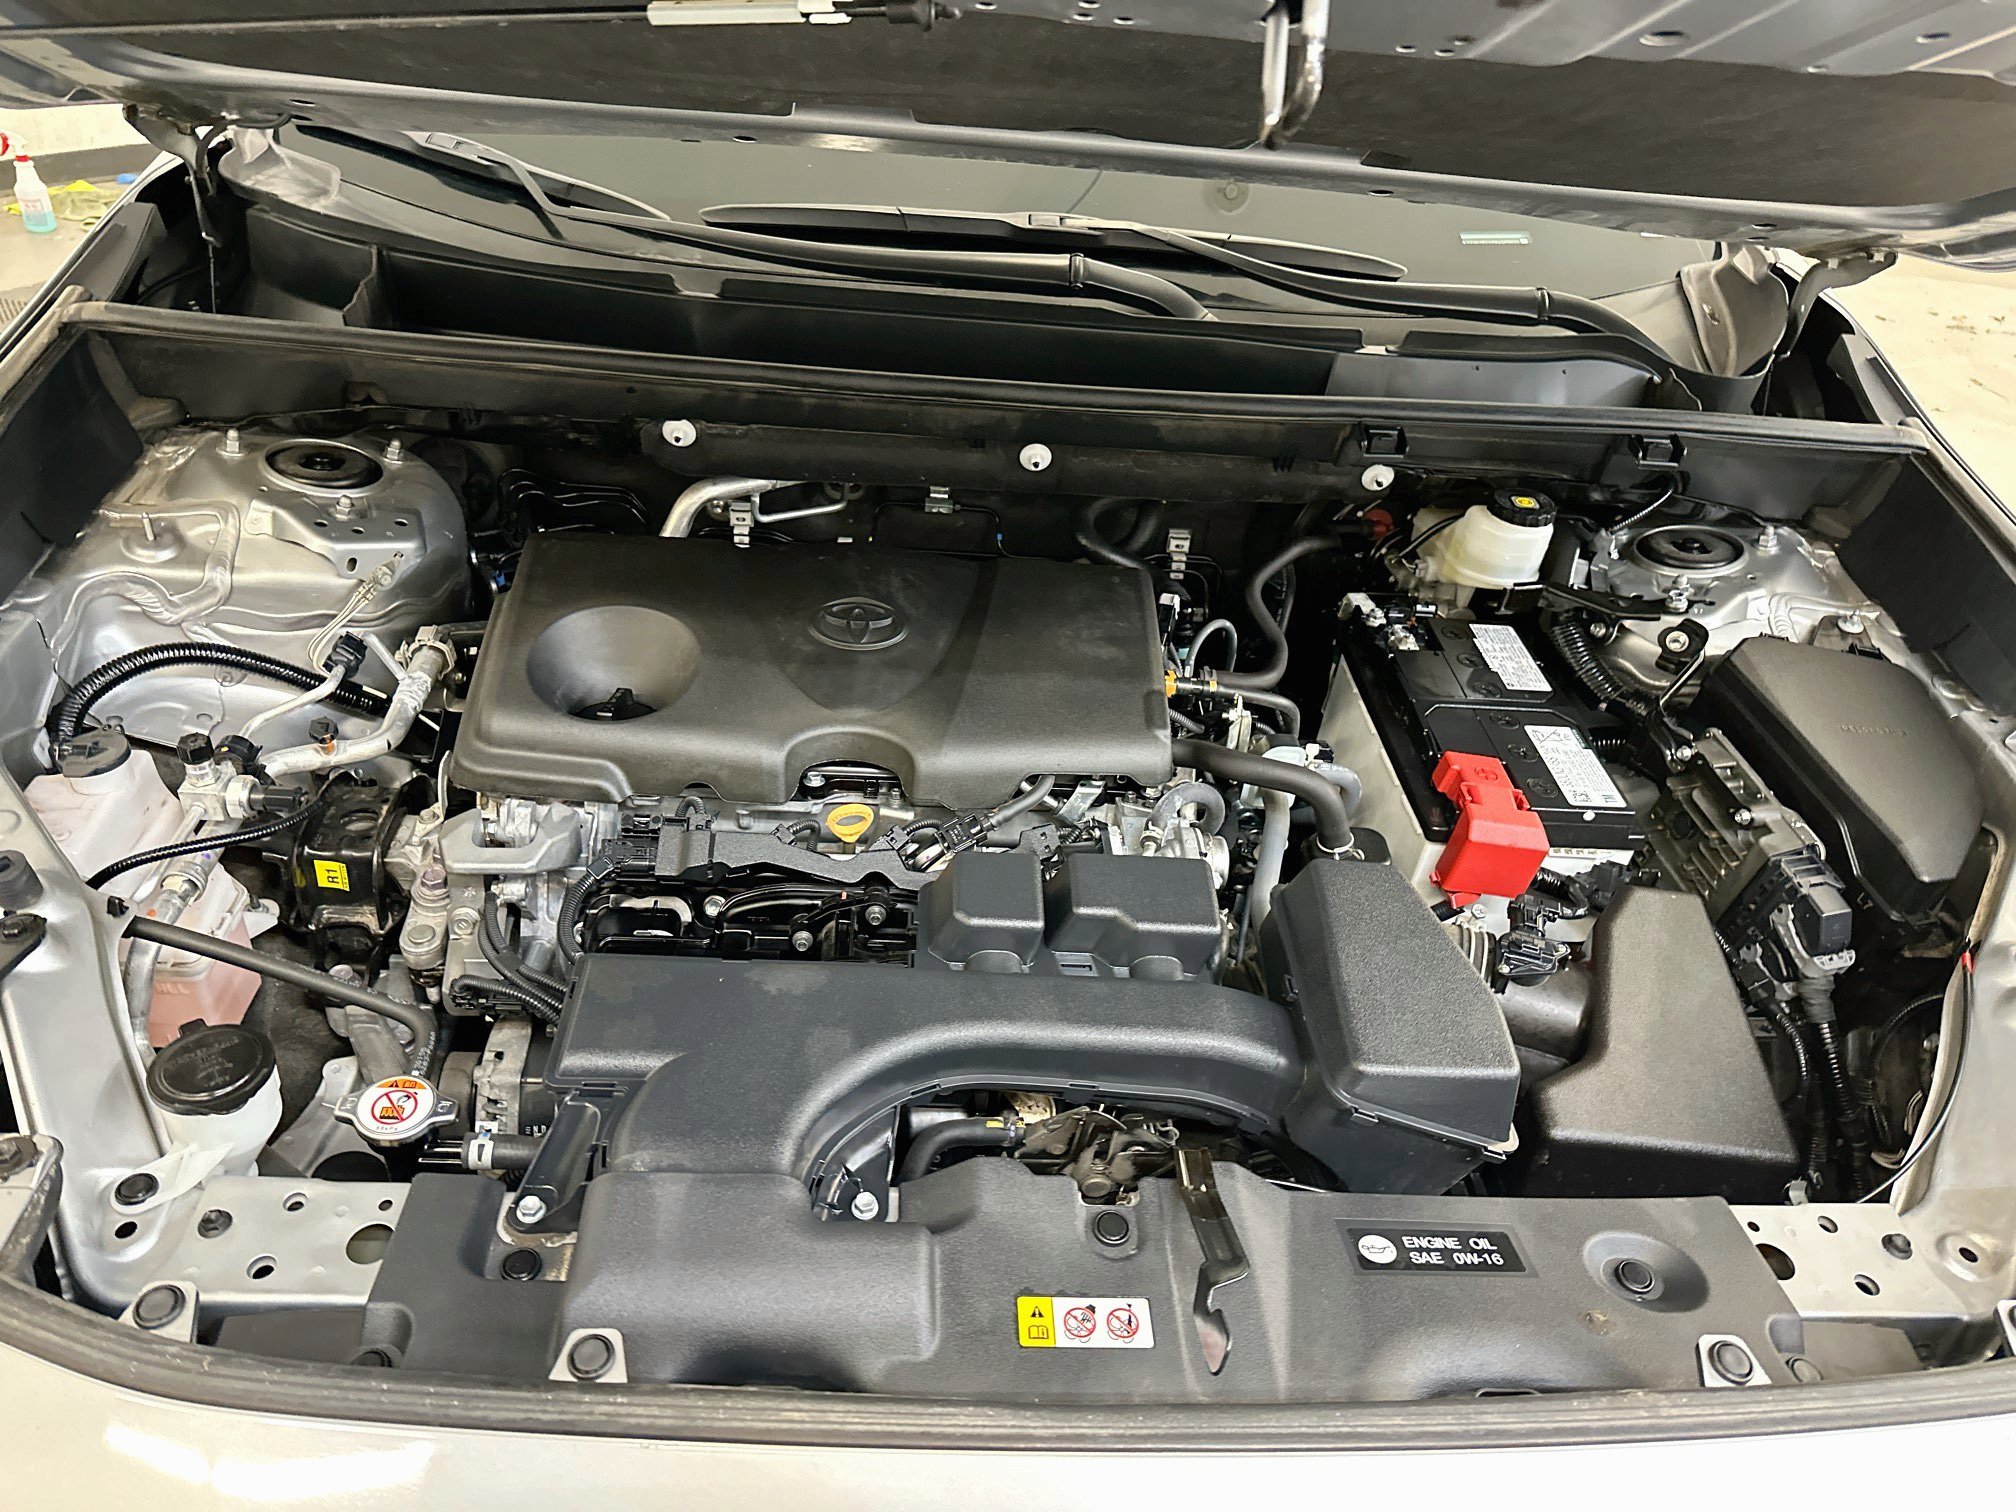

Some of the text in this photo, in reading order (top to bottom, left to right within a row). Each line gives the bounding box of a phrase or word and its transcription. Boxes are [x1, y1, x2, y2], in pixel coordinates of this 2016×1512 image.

[325, 868, 340, 884] R1
[1401, 1236, 1498, 1250] ENGINE OIL
[1409, 1251, 1504, 1265] SAE 0W-16
